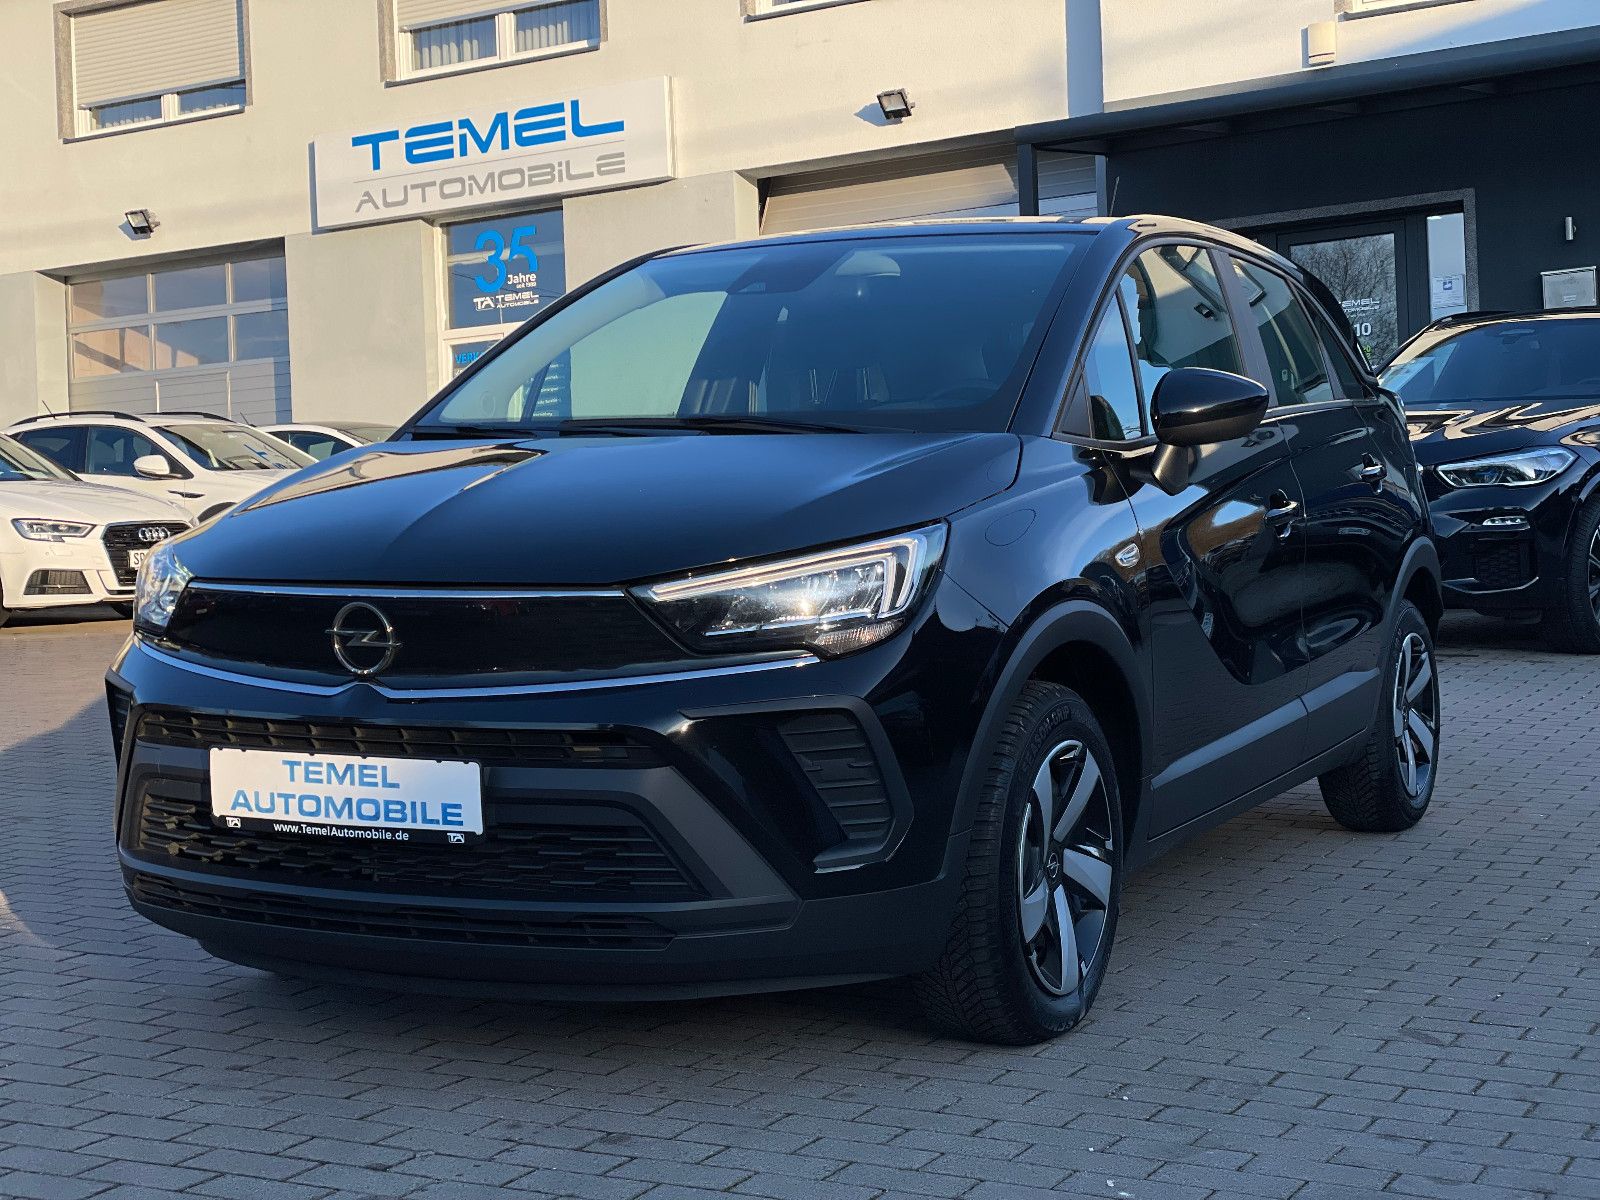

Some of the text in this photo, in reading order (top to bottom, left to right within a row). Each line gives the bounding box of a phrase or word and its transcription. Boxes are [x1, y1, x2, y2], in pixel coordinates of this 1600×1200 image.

[351, 99, 625, 171] TEMEL
[474, 224, 539, 293] 35
[507, 272, 537, 285] Jahre
[495, 291, 539, 303] TEMEL
[1340, 298, 1380, 308] EMEL
[1353, 322, 1372, 337] 10
[455, 351, 483, 364] VERK
[281, 759, 400, 789] TEMEL
[230, 789, 464, 827] AUTOMOBILE
[273, 822, 409, 841] www.TemelAutomobile.de
